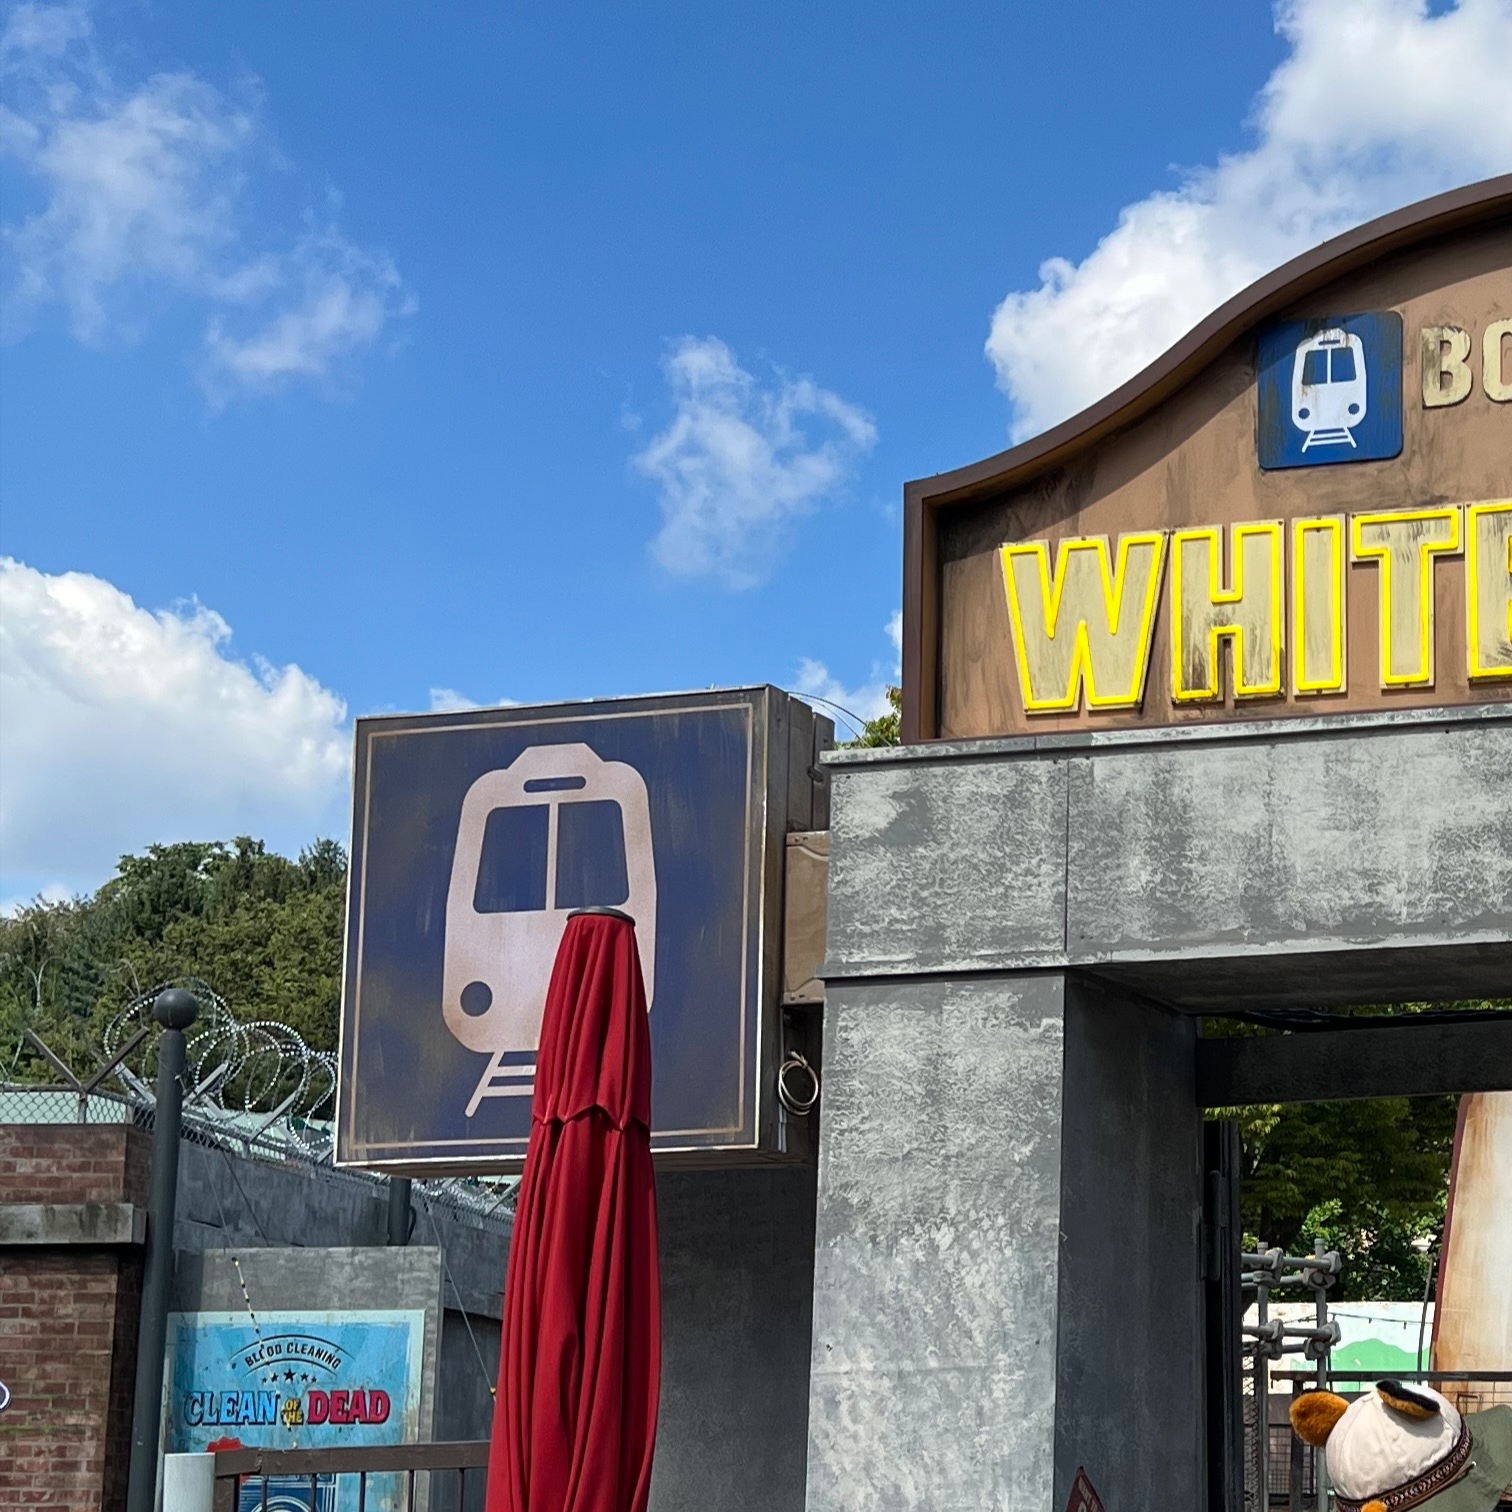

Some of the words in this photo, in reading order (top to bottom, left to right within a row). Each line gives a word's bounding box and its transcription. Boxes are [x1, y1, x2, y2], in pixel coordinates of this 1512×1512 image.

[287, 1341, 343, 1370] CLEANING
[184, 1389, 281, 1426] CLEAN
[285, 1398, 301, 1411] OF
[307, 1389, 392, 1425] DEAD
